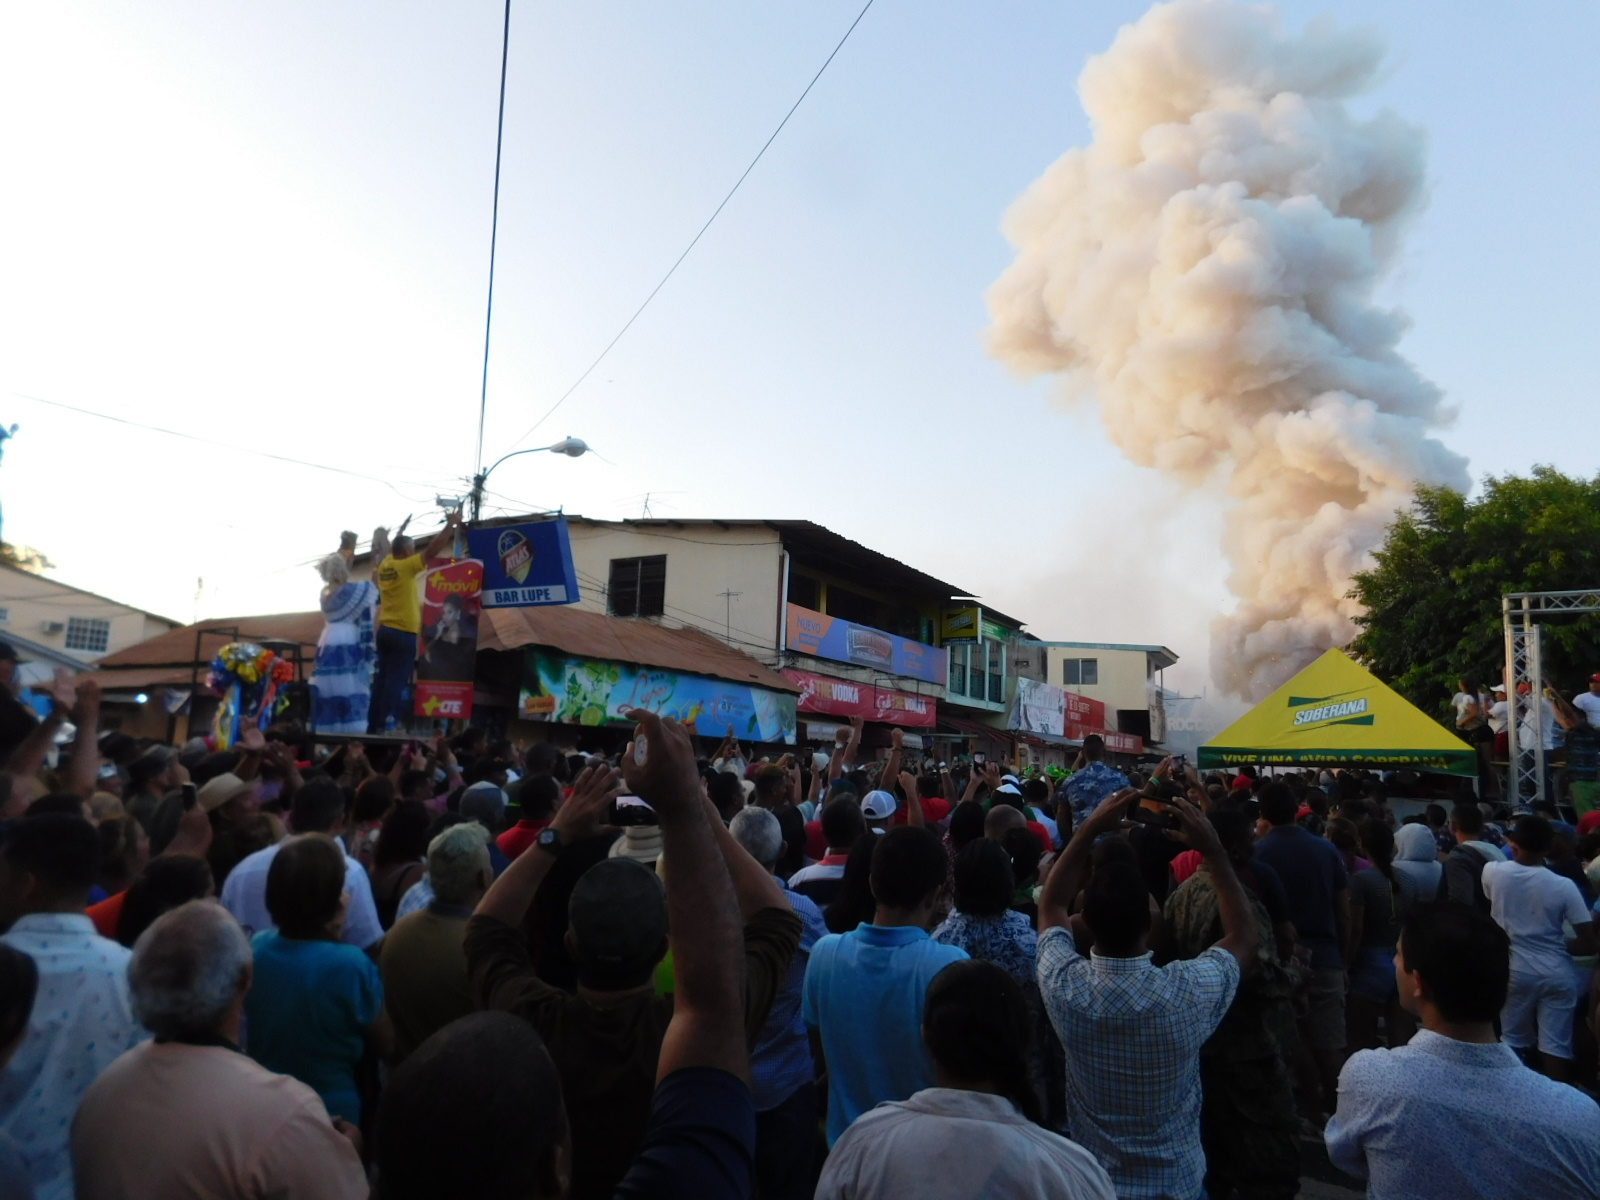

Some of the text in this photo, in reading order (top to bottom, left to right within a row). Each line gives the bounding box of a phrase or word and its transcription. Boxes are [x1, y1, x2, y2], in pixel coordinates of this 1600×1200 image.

[506, 545, 530, 574] ATLAS
[494, 588, 551, 604] BAR LUPE
[831, 683, 859, 704] VODKA
[1293, 698, 1368, 726] SOBERANA
[1222, 754, 1257, 764] VIVE
